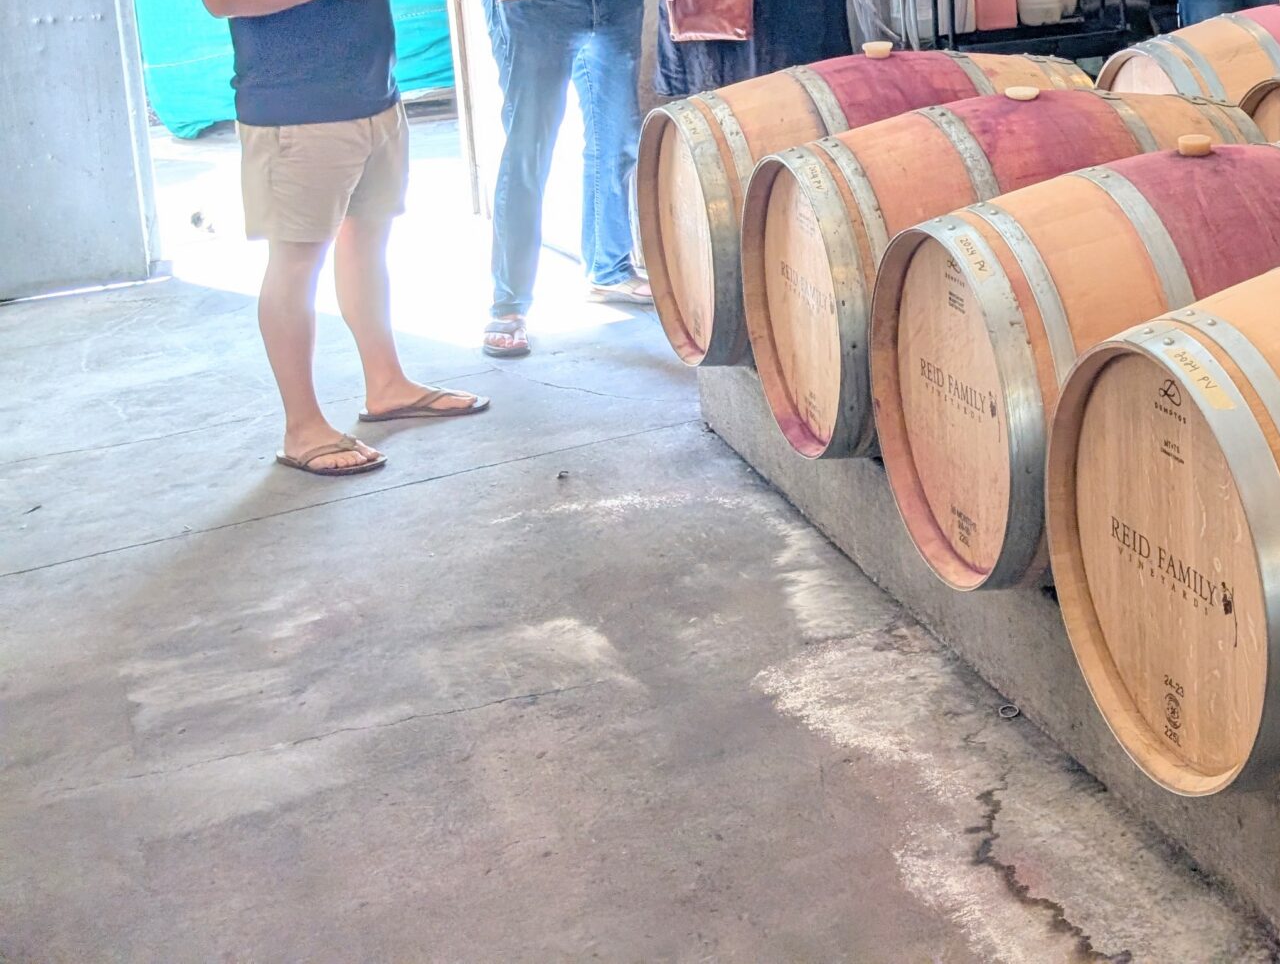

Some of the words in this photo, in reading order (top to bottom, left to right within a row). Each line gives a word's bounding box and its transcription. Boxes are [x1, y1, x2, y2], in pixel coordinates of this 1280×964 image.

[960, 238, 977, 256] 2024
[920, 357, 945, 388] REID
[948, 374, 986, 414] FAMILY
[1174, 351, 1200, 373] 2024
[1197, 376, 1218, 390] PV
[1111, 516, 1151, 559] REID
[1158, 546, 1217, 607] FAMILY
